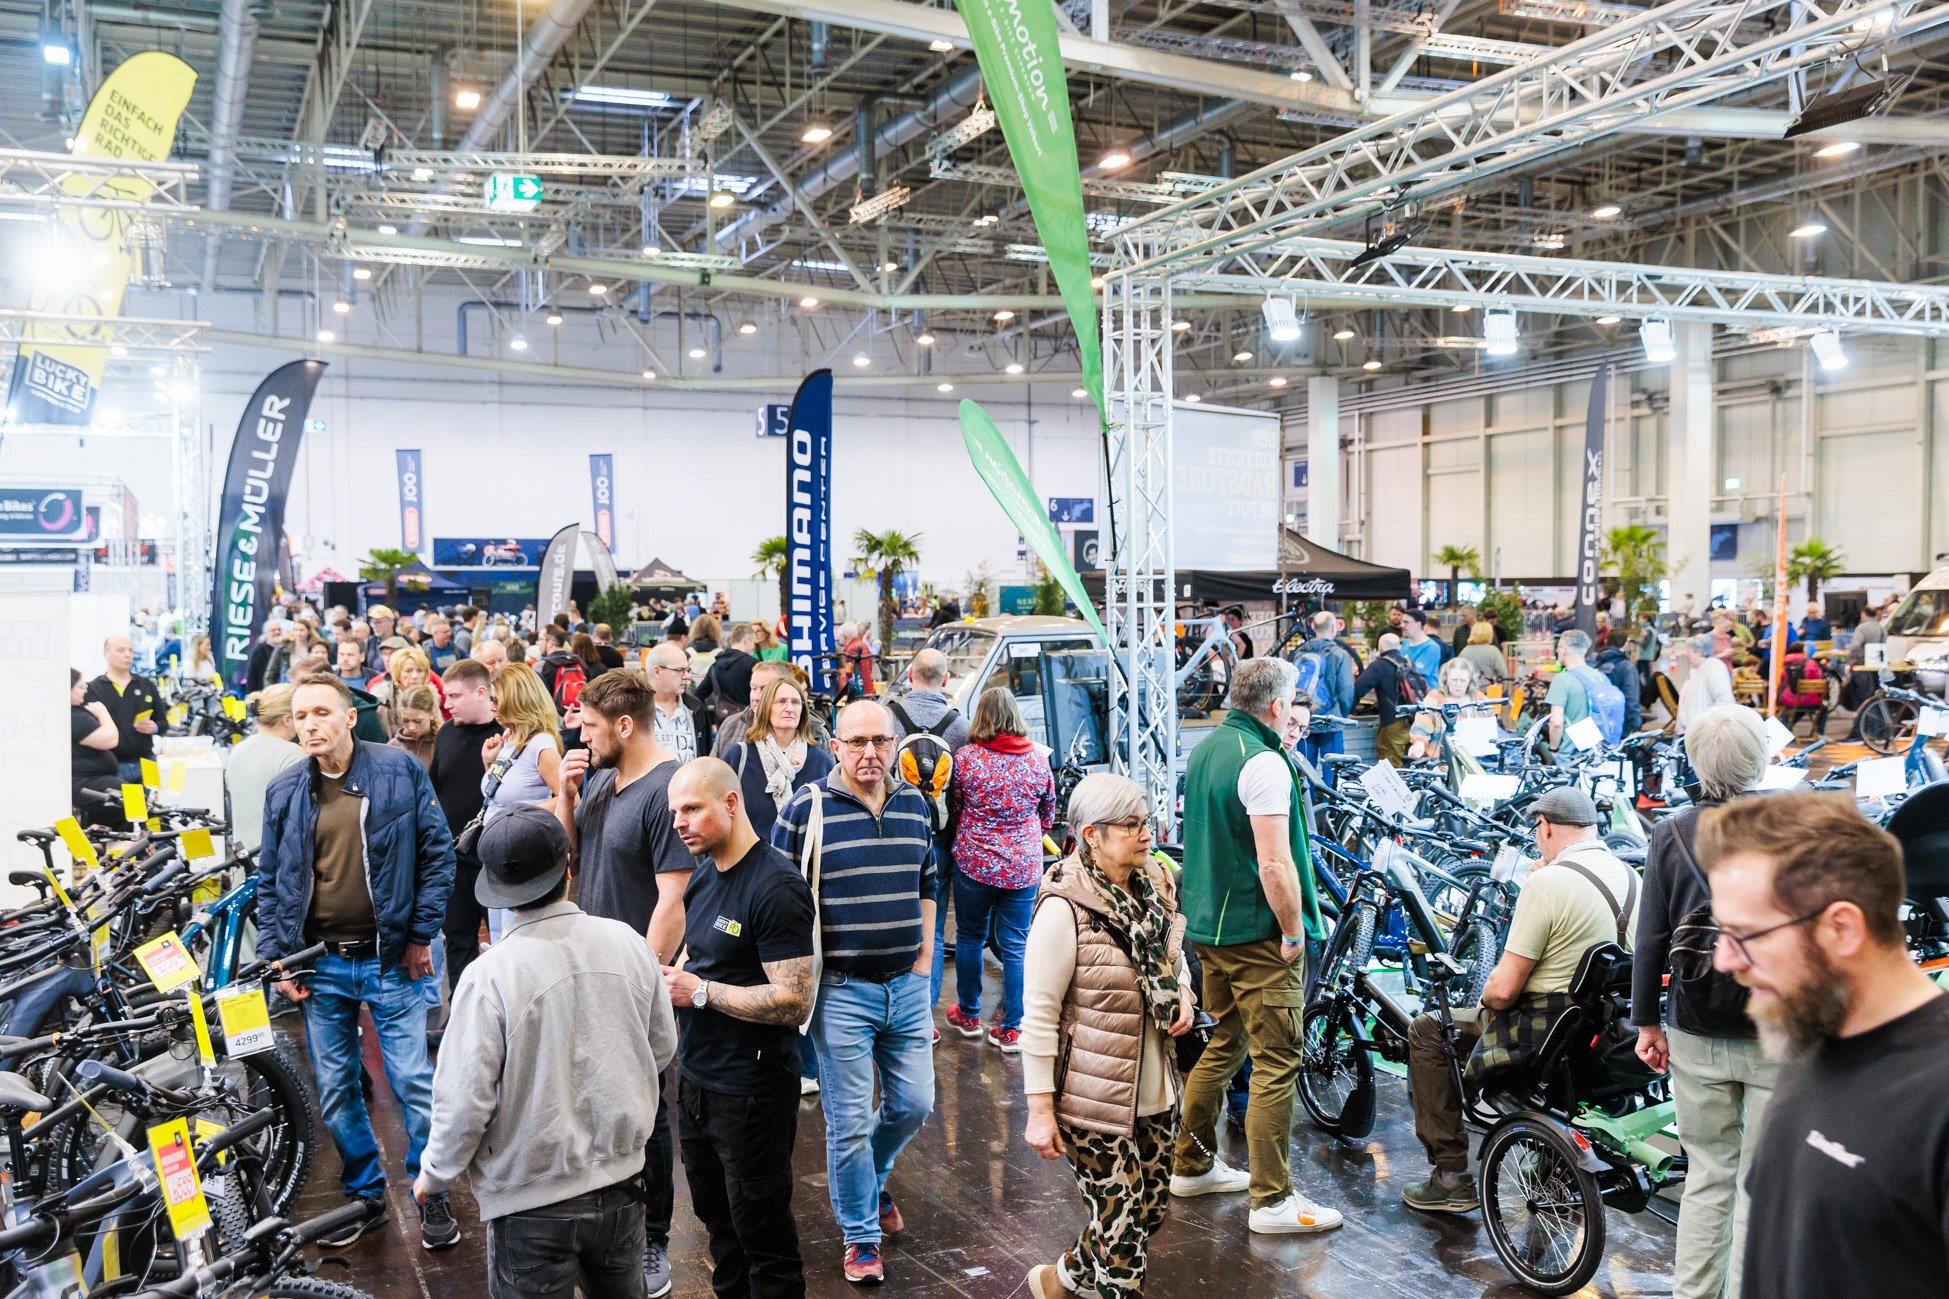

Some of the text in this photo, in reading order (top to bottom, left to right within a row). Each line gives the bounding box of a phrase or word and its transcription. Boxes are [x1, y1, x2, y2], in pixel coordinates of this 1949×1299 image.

[104, 104, 132, 129] DAS
[110, 90, 164, 135] EINFACH
[94, 133, 123, 158] RAD
[100, 118, 157, 162] RICHTIGE
[32, 367, 86, 402] BIKE
[36, 355, 90, 387] LUCKY
[757, 406, 766, 436] 5
[774, 407, 789, 434] 5
[819, 436, 828, 562] CENTER
[1050, 499, 1058, 512] 6
[226, 394, 292, 662] RIESE & MÜLLER
[1582, 448, 1601, 607] connex
[792, 428, 813, 689] SHIMANO
[1272, 578, 1336, 594] Electra
[235, 1034, 258, 1047] 4299
